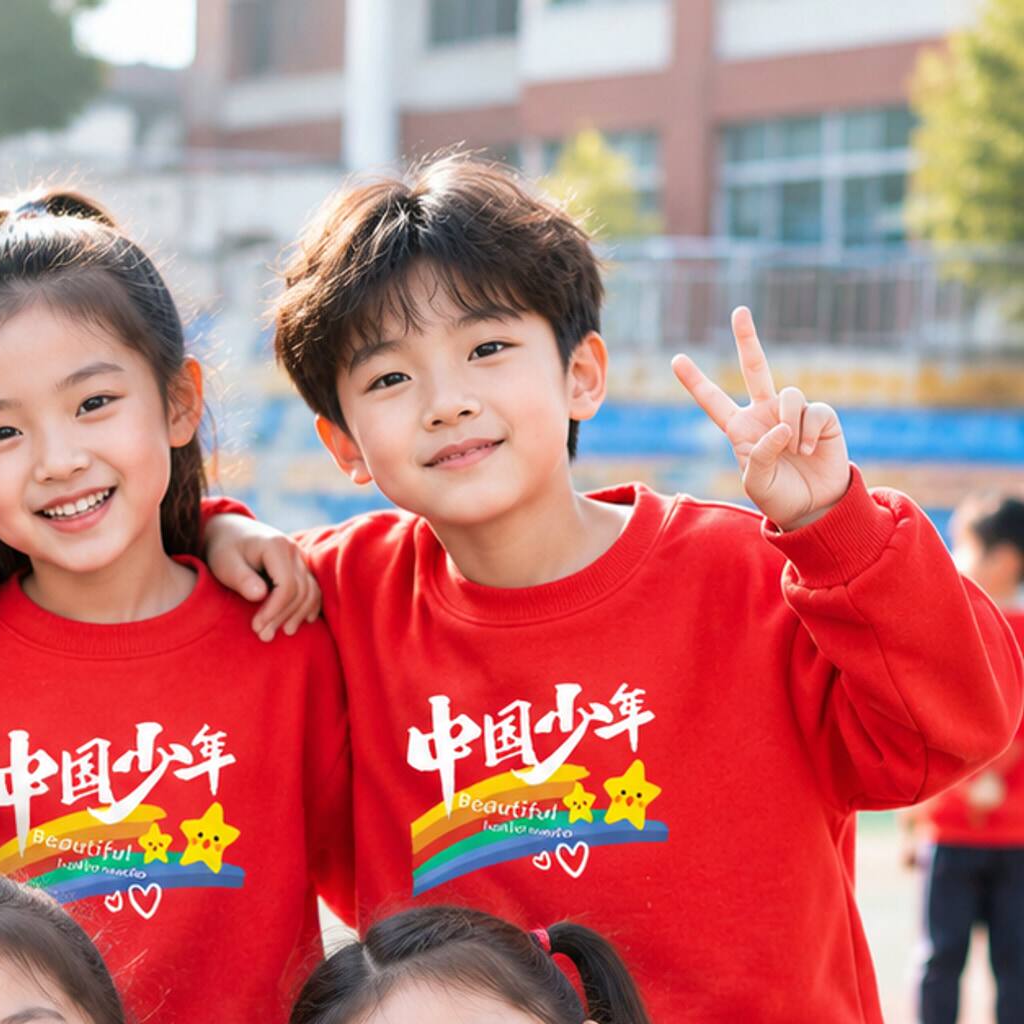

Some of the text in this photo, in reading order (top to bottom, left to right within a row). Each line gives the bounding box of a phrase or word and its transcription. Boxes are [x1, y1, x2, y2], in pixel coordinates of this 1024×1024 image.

[407, 683, 655, 820] 中国少年
[458, 793, 557, 821] Beautiful
[32, 829, 133, 862] Beautiful
